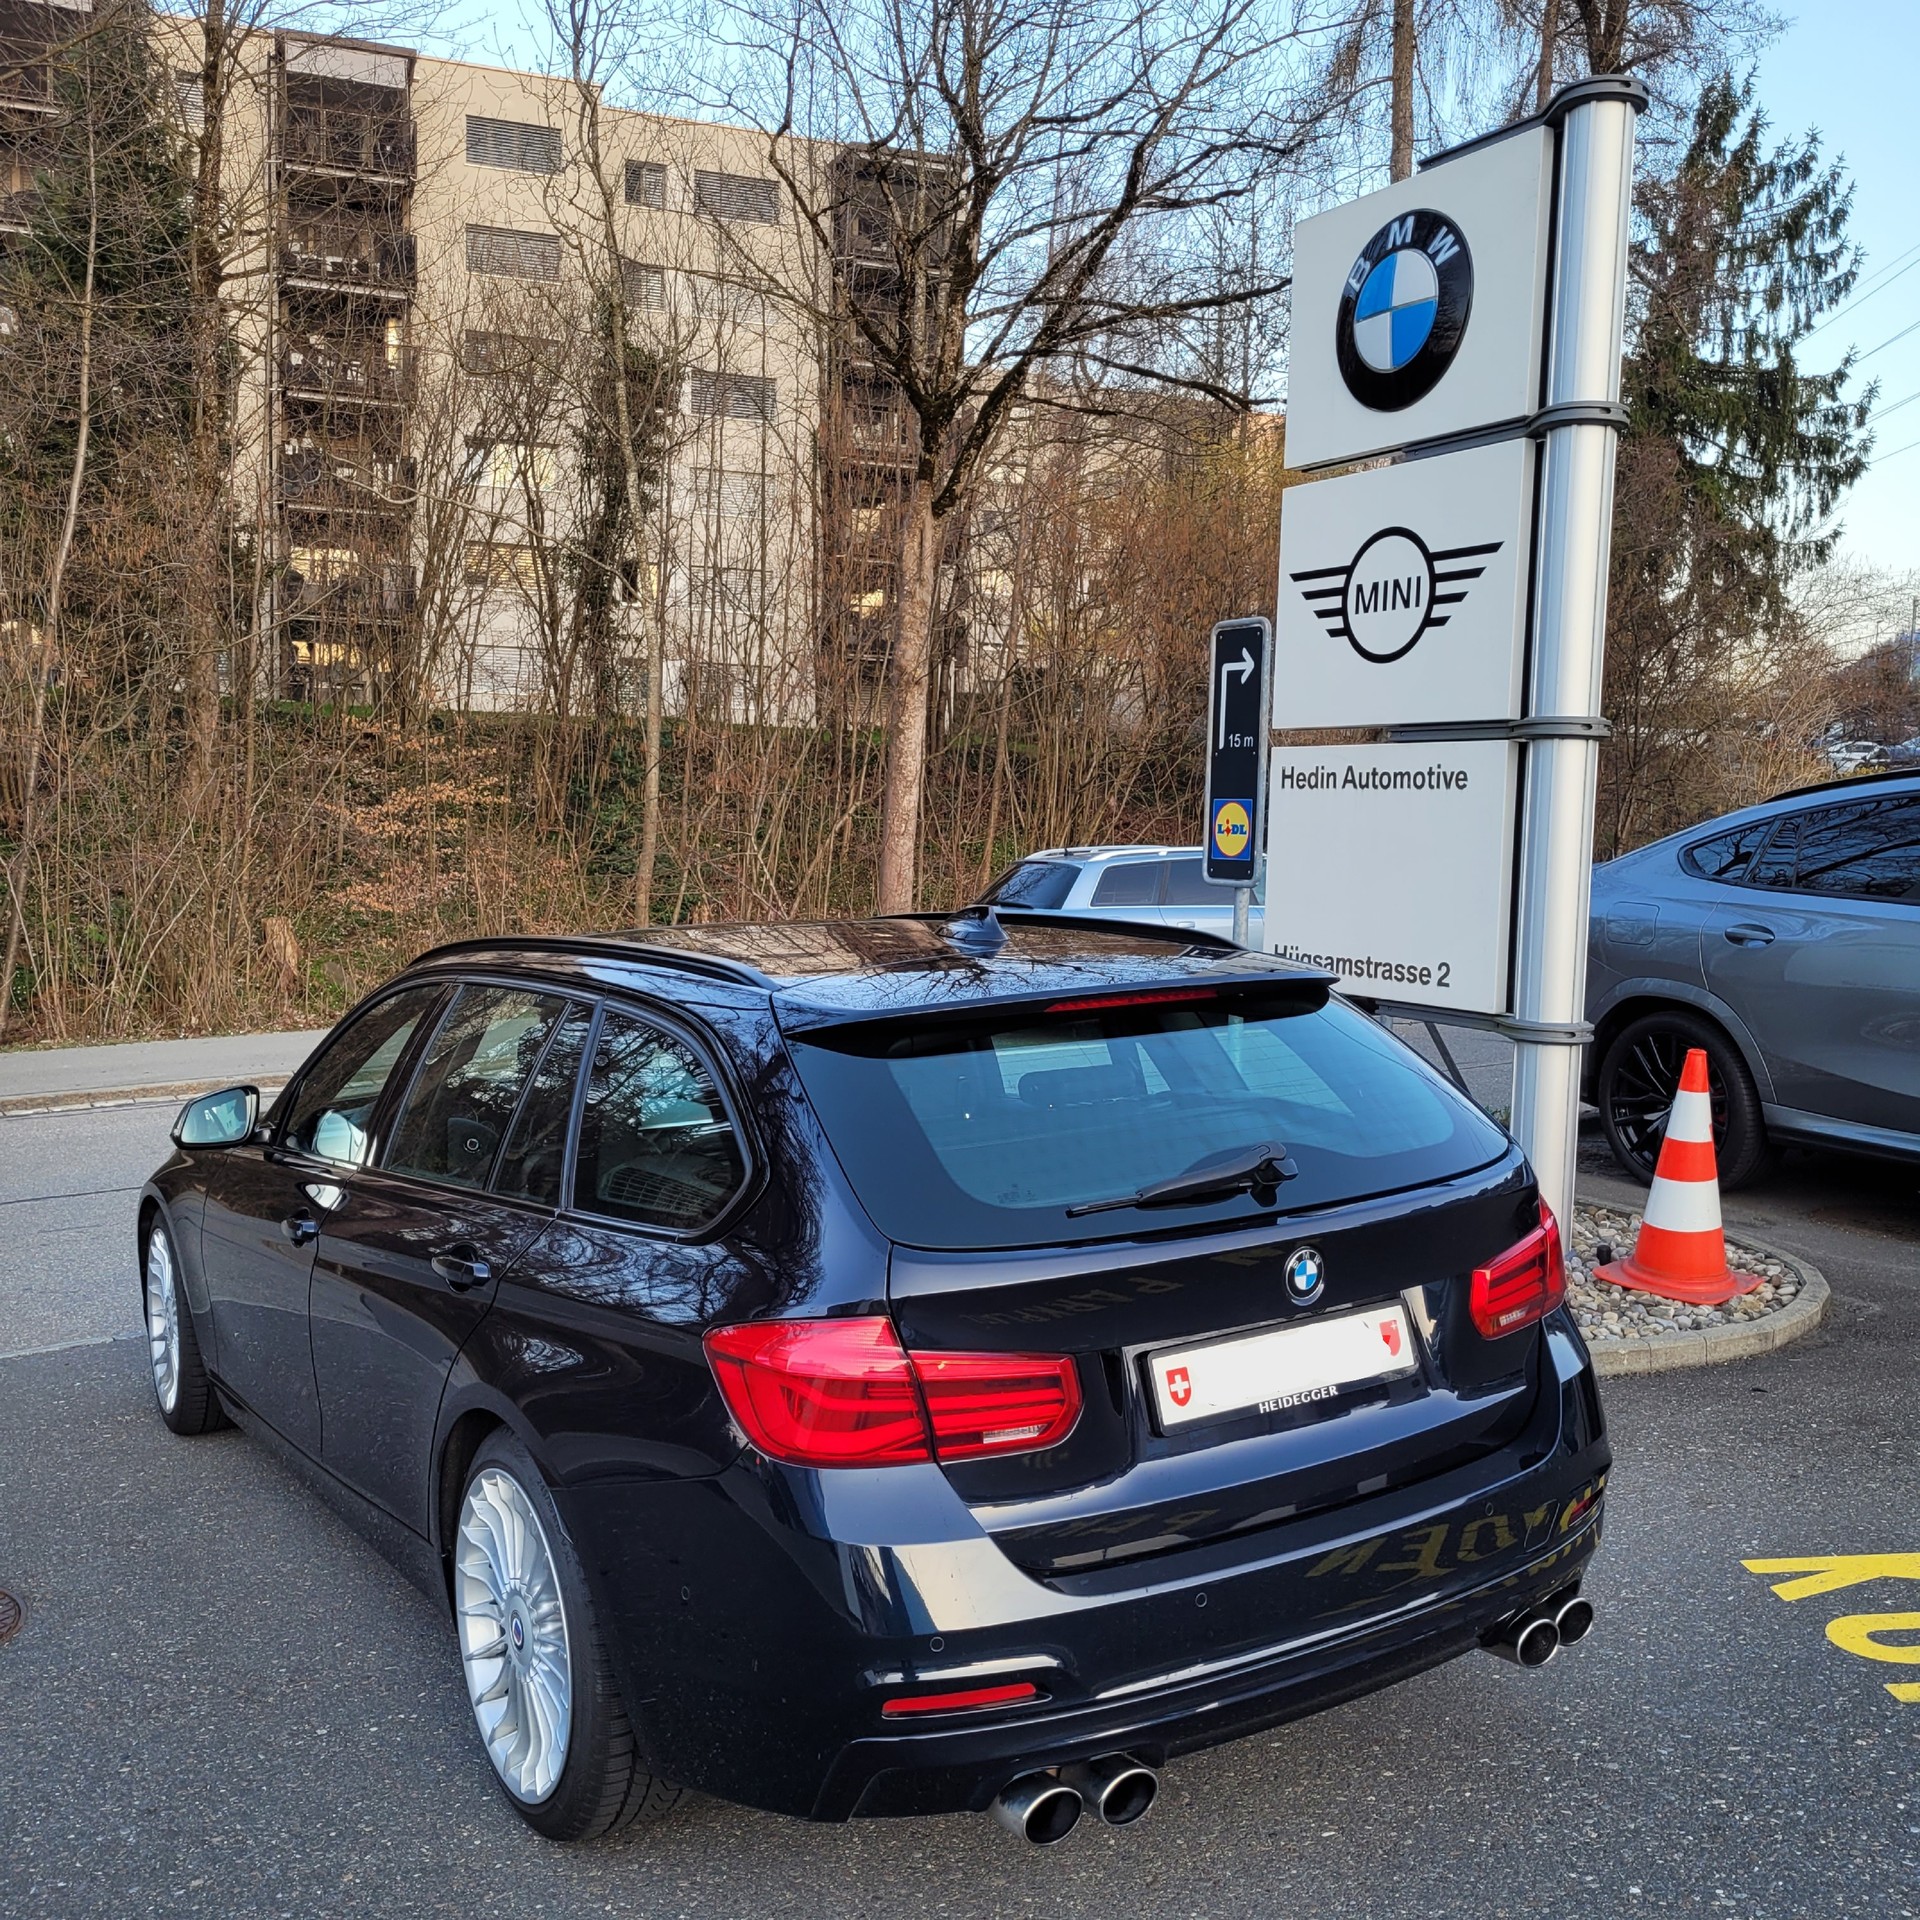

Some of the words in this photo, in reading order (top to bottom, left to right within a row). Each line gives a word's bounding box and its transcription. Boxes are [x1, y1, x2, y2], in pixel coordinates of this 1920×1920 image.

[1348, 215, 1460, 291] BMW
[1355, 575, 1422, 615] MINI
[1228, 733, 1241, 748] 15
[1243, 735, 1254, 748] m
[1281, 766, 1337, 790] Hedin
[1342, 764, 1468, 790] Automotive
[1436, 961, 1451, 988] 2
[1291, 1251, 1322, 1269] BMW
[1259, 1385, 1339, 1413] HEIDEGGER
